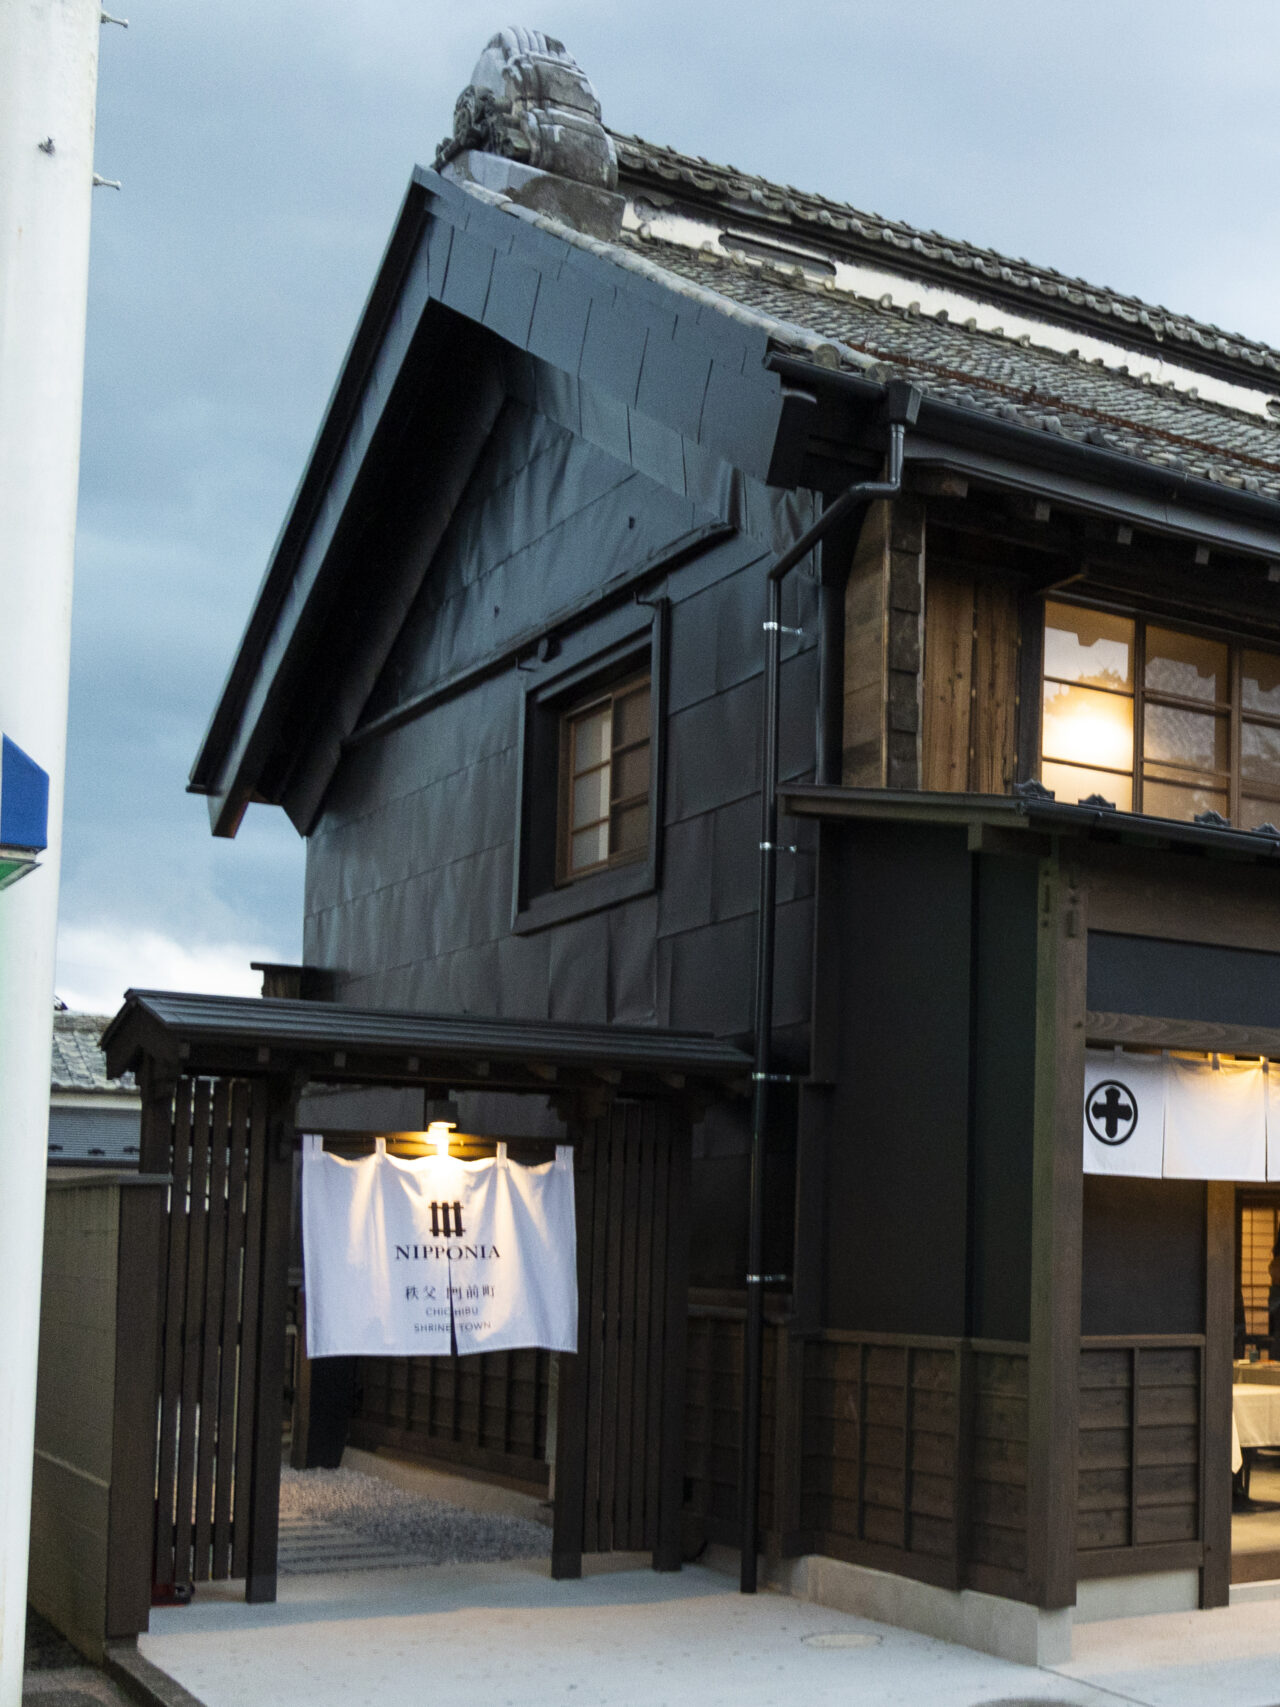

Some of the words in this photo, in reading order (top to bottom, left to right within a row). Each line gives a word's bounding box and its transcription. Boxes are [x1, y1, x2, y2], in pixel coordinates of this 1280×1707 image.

[394, 1244, 500, 1260] NIPPONIA
[405, 1284, 437, 1300] 秩父
[425, 1306, 479, 1318] CHICHIBU
[413, 1322, 452, 1333] SHRINE
[460, 1320, 491, 1332] TOWN
